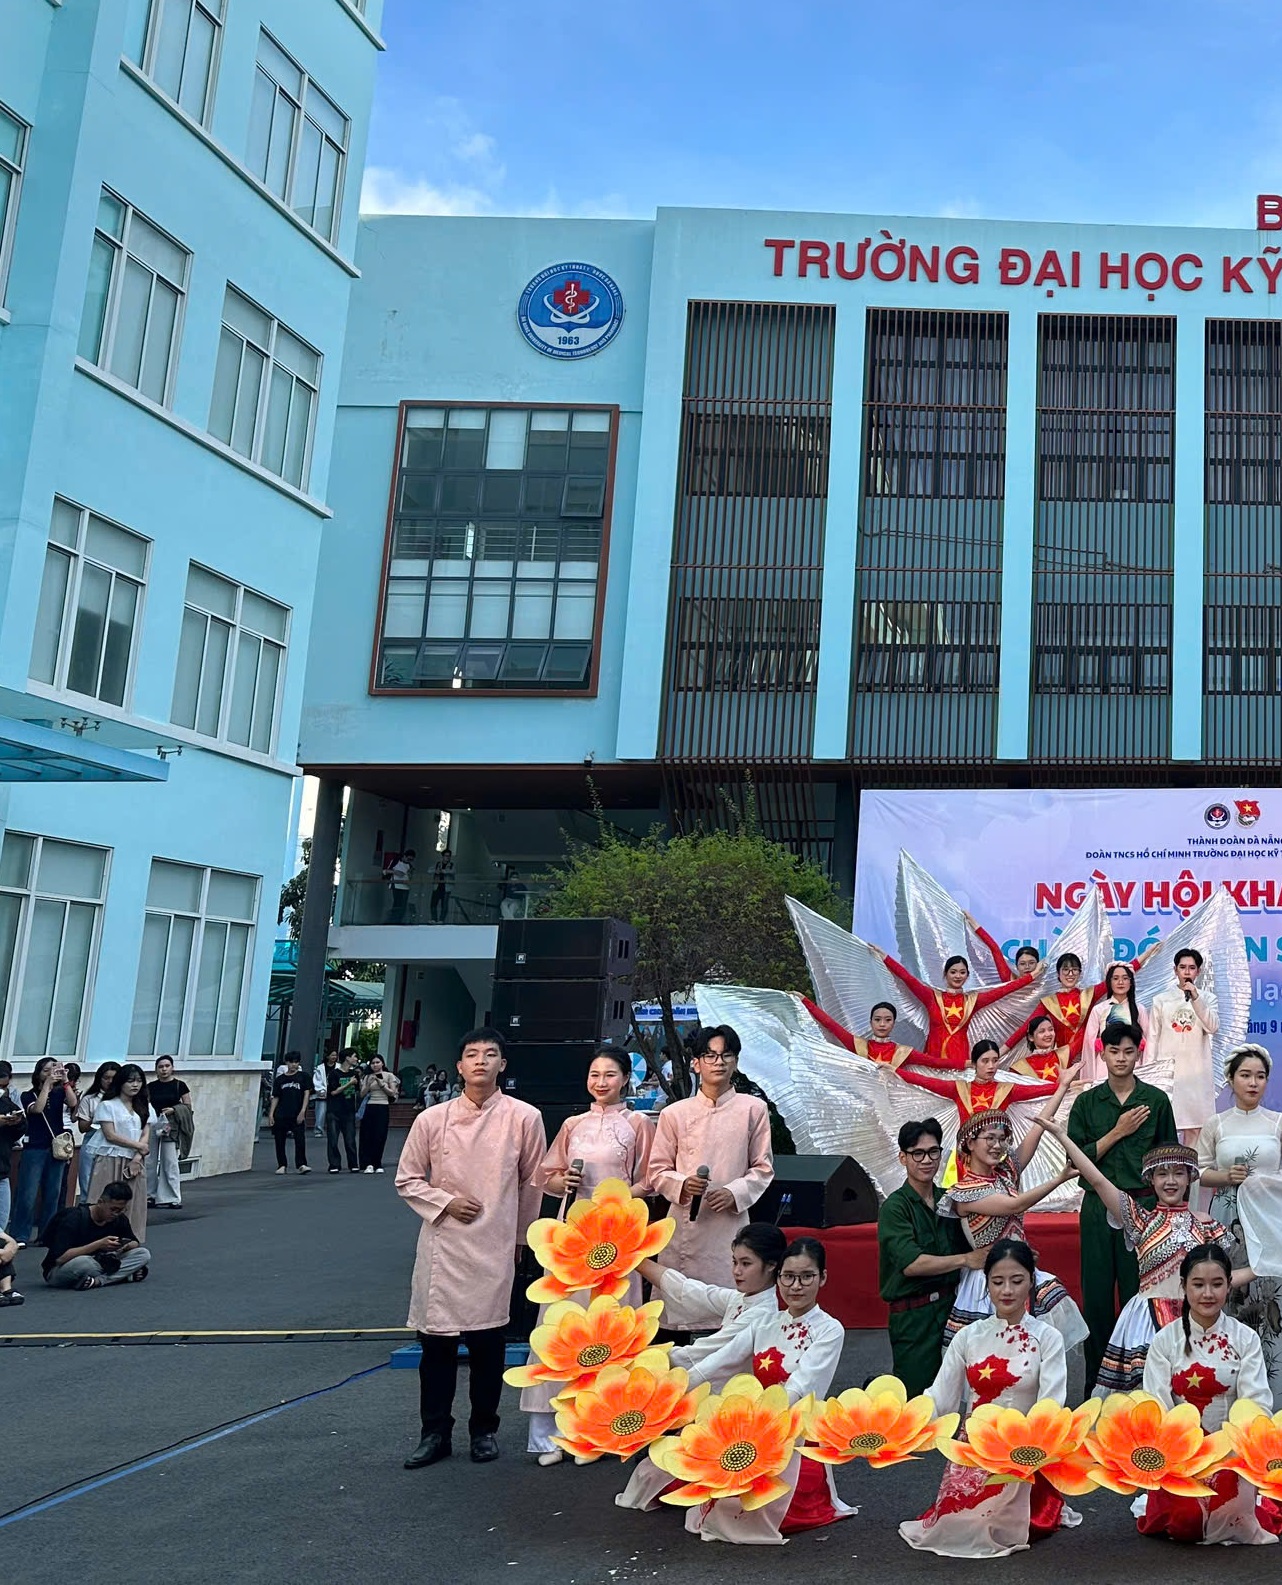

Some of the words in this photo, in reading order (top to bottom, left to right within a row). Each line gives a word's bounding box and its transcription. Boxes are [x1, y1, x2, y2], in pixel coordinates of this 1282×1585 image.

[764, 230, 980, 284] TRƯỜNG
[998, 248, 1080, 298] ĐẠI
[1100, 252, 1203, 301] HỌC
[557, 336, 579, 345] 1963
[1187, 836, 1218, 845] THÀNH
[1136, 847, 1150, 858] HỒ
[1151, 849, 1167, 858] CHÍ
[1193, 848, 1229, 858] TRƯỜNG
[1230, 850, 1246, 860] ĐẠI
[1247, 850, 1266, 860] HỌC
[1268, 848, 1279, 857] KỸ
[1035, 869, 1137, 911] NGÀY
[1143, 869, 1213, 918] HỘI
[1270, 1019, 1278, 1033] 9
